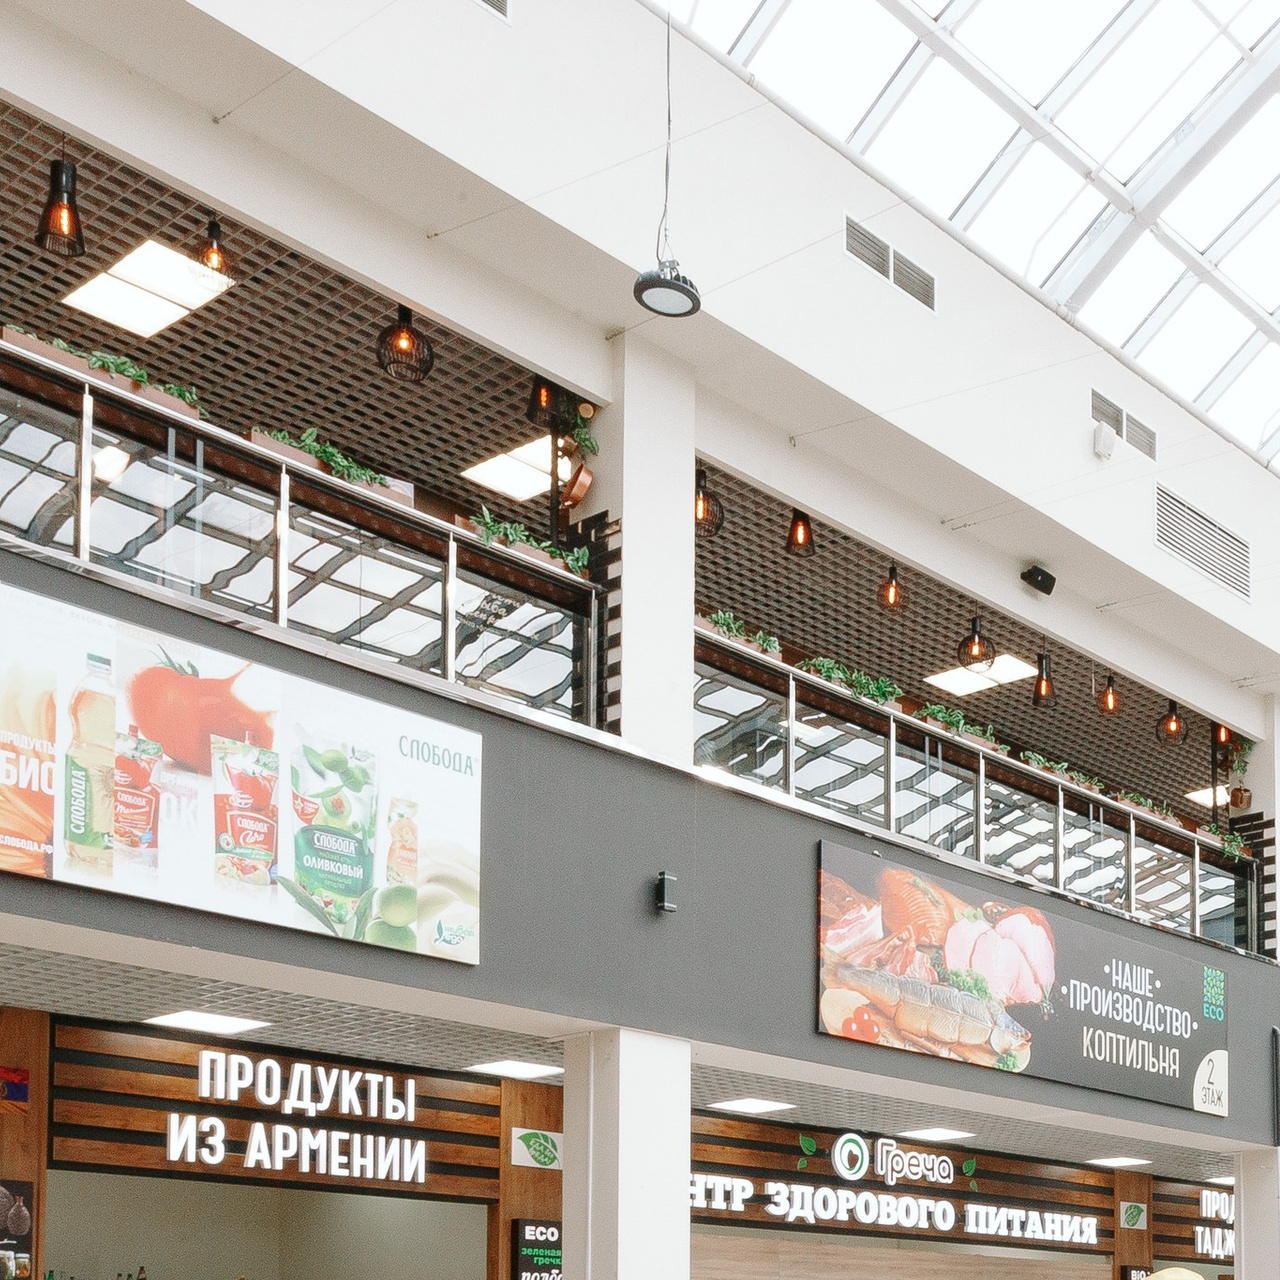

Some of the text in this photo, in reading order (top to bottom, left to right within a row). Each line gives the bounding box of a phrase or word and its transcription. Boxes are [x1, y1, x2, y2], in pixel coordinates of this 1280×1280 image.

[0, 749, 55, 795] БИО
[399, 735, 474, 776] СЛОБОДА
[70, 769, 86, 834] СЛОБОДА
[237, 817, 268, 833] СЛОБОДА
[313, 832, 356, 854] СЛОБОДА
[303, 855, 364, 879] ОЛИВКОВЫЙ
[1112, 958, 1154, 998] НАШЕ
[1069, 979, 1191, 1039] ПРОИЗВОДСТВО
[1203, 1003, 1225, 1021] ECO
[1083, 1026, 1180, 1078] КОПТИЛЬНЯ
[1207, 1058, 1215, 1085] 2
[199, 1050, 416, 1123] ПРОДУКТЫ
[1201, 1086, 1224, 1108] ЭТАЖ
[167, 1113, 427, 1184] ИЗ АРМЕНИИ
[875, 1137, 955, 1186] Греча
[689, 1173, 1098, 1245] НТР ЗДОРОВОГО ПИТАНИЯ
